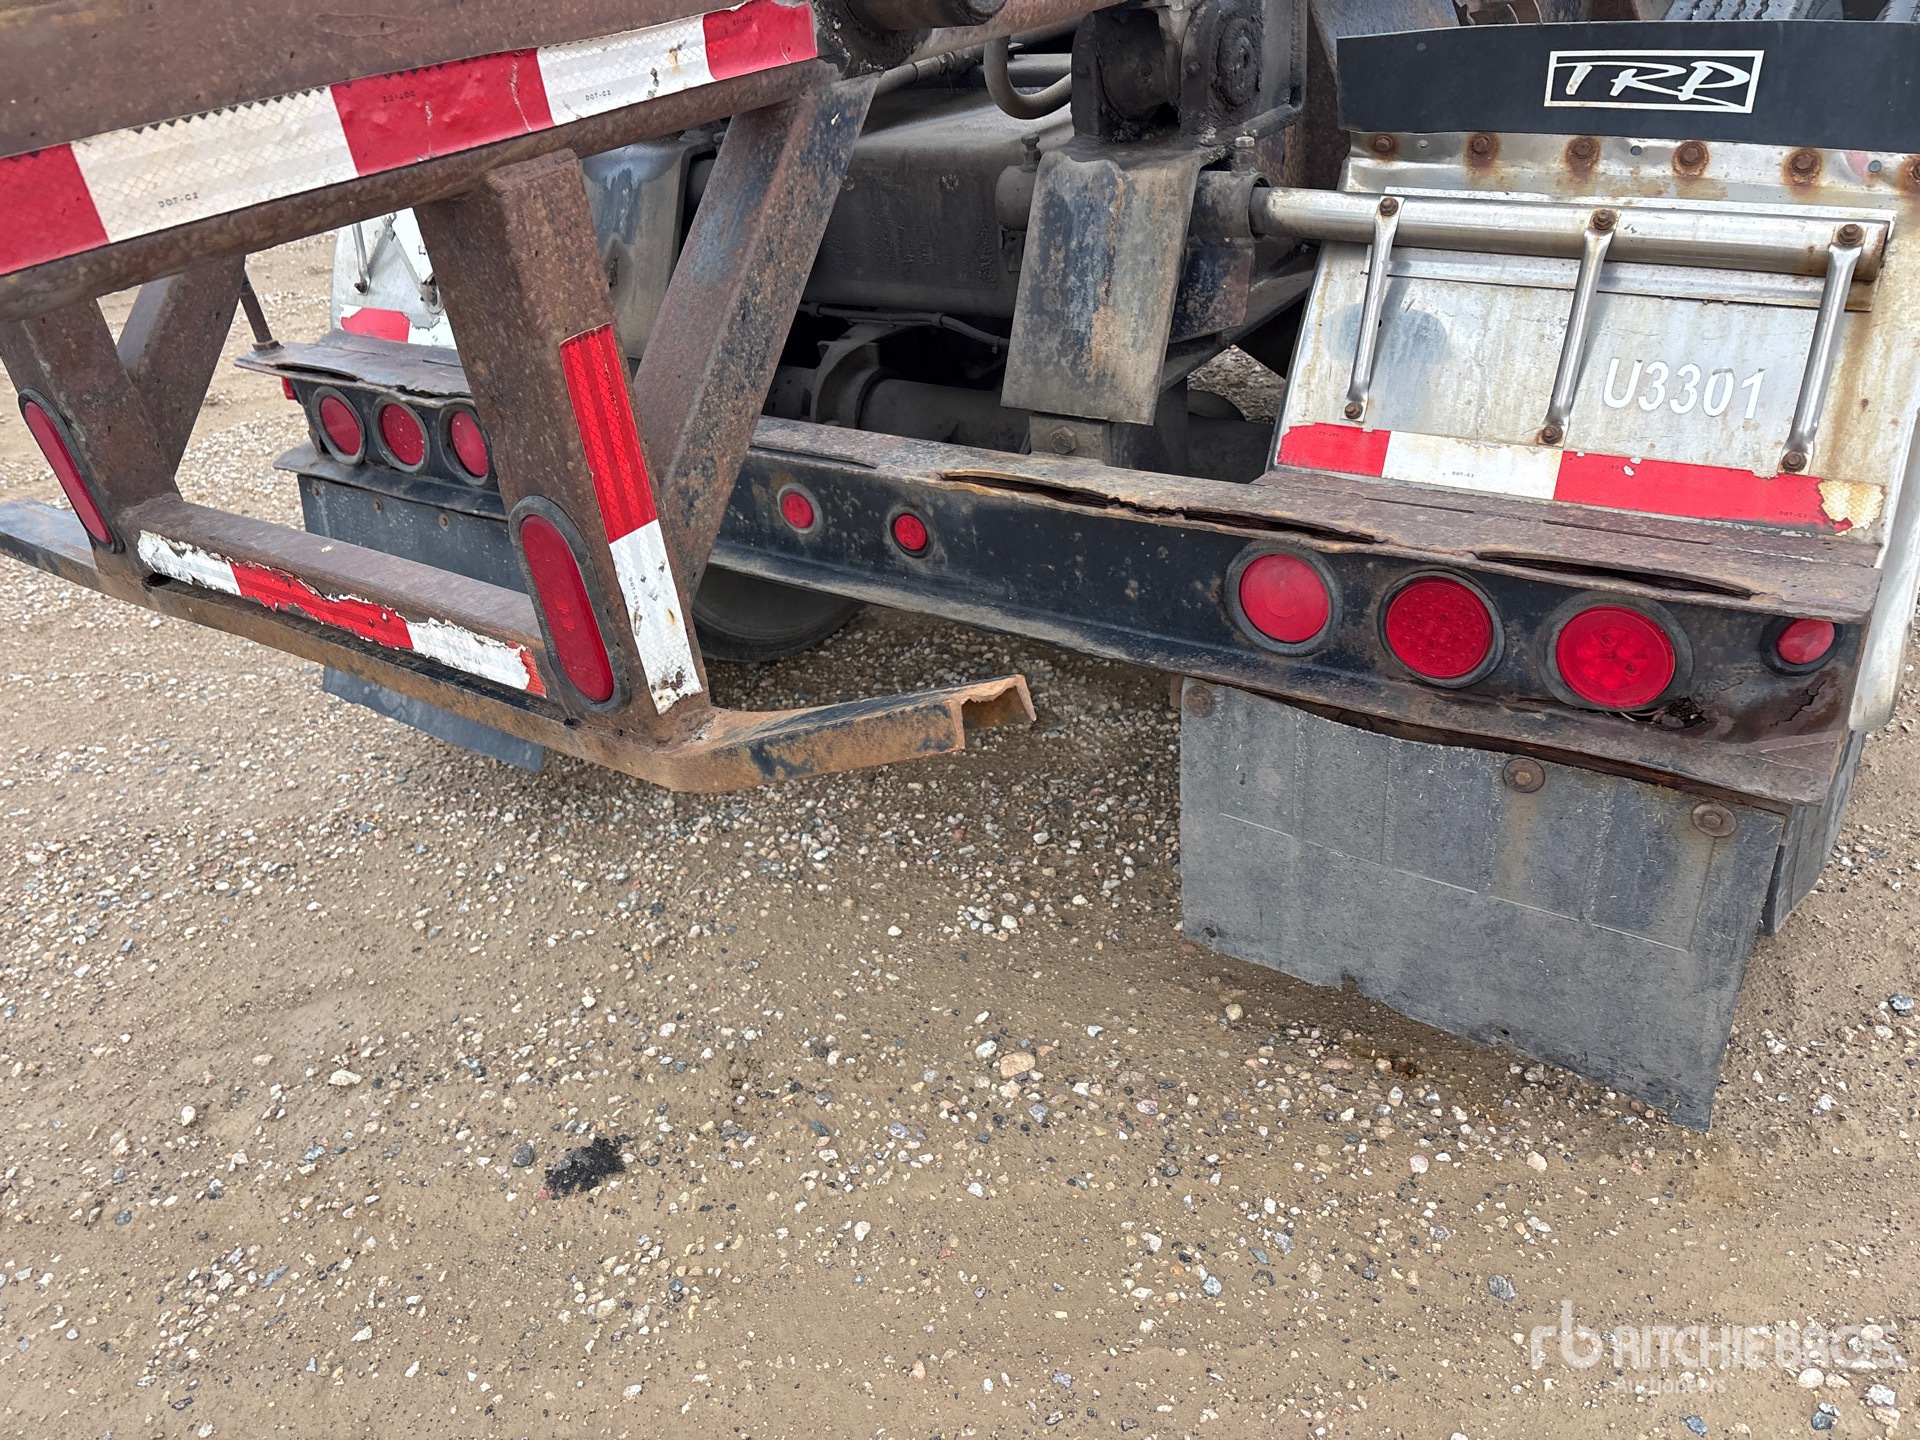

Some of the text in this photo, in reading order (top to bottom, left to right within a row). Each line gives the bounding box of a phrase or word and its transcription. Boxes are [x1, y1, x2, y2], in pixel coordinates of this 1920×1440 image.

[585, 89, 612, 101] DOT-C2
[1554, 60, 1751, 101] TRP
[158, 191, 199, 208] DOT-C2
[1603, 357, 1765, 420] U3301
